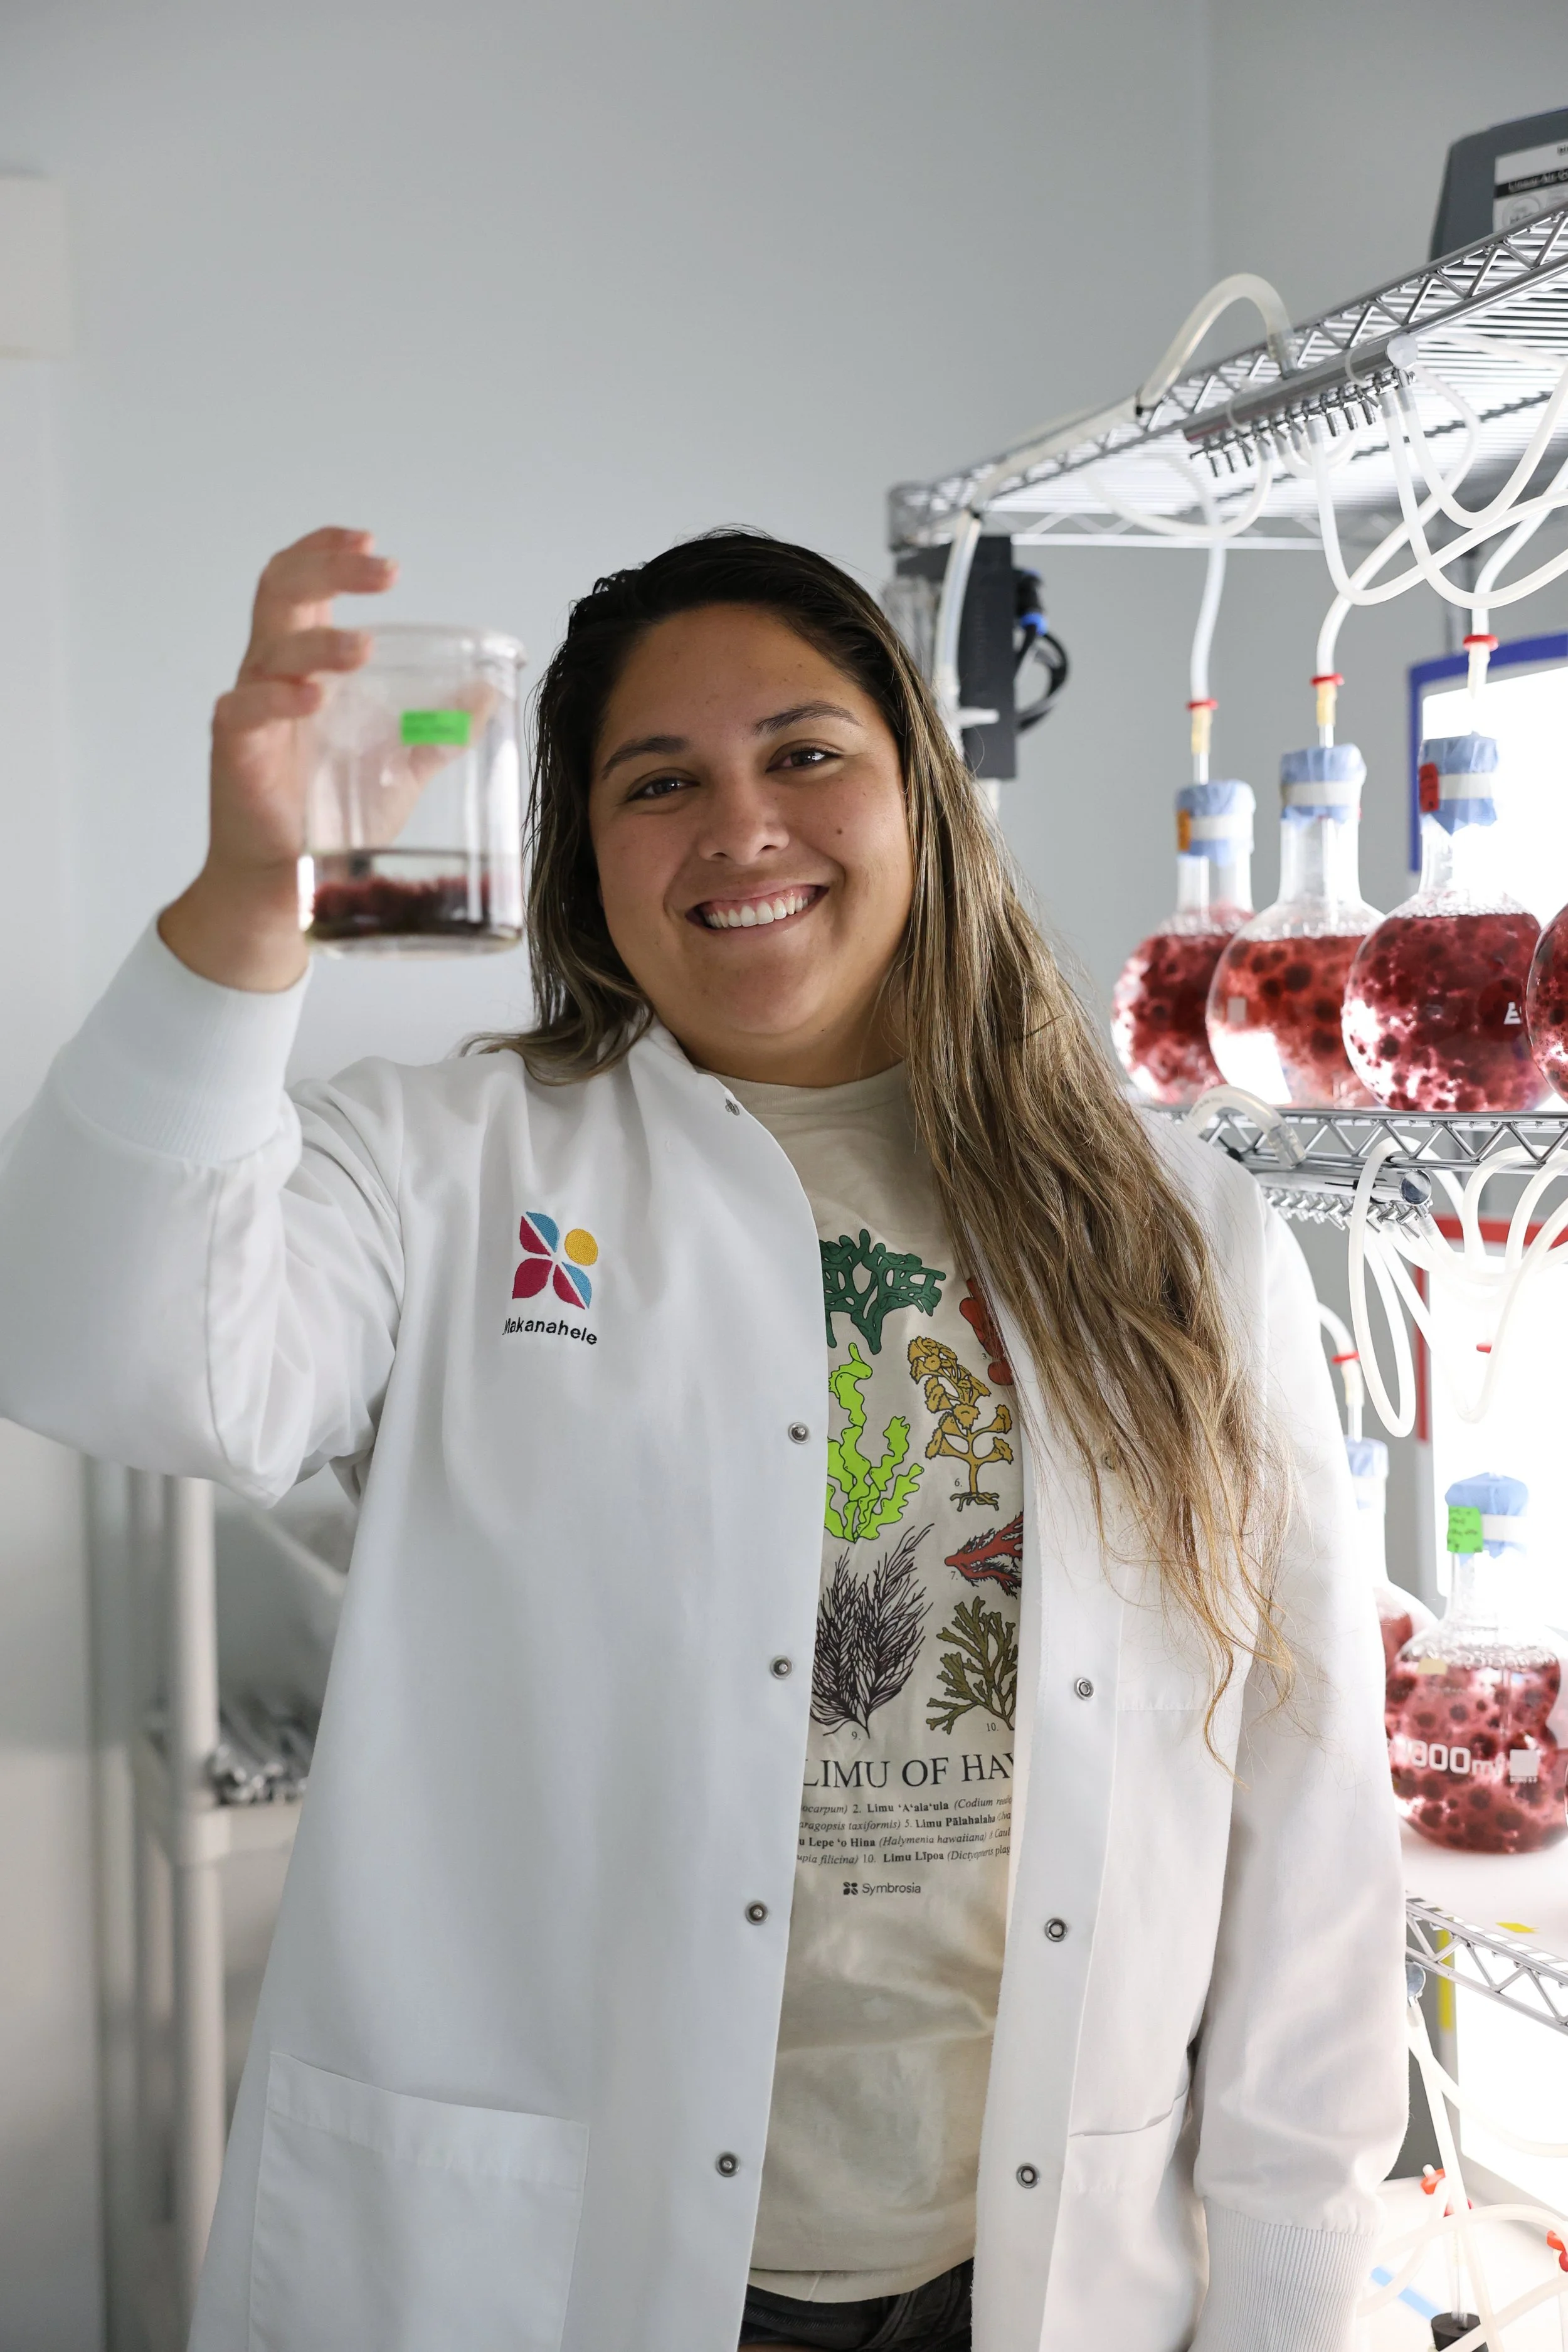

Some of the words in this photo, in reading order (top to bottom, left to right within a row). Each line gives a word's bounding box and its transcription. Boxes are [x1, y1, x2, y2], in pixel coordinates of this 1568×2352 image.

[502, 1317, 597, 1345] Makanahele
[954, 1478, 962, 1487] 6.
[951, 1571, 958, 1580] 7.
[986, 1722, 999, 1732] 10.
[852, 1732, 861, 1740] 9.
[902, 1757, 949, 1786] OF
[853, 1804, 861, 1813] 2.
[867, 1803, 894, 1813] Limu
[954, 1798, 993, 1810] (Codium
[849, 1820, 901, 1832] taxiformis)
[904, 1820, 913, 1828] 5.
[916, 1819, 942, 1828] Limu
[809, 1837, 834, 1849] Lepe
[850, 1838, 876, 1847] Hina
[879, 1835, 934, 1848] (Halymenia
[937, 1831, 987, 1844] hawaiiana)
[819, 1854, 859, 1865] filicina)
[863, 1854, 876, 1863] 10.
[884, 1853, 911, 1863] Limu
[862, 1882, 921, 1896] Symbrosia
